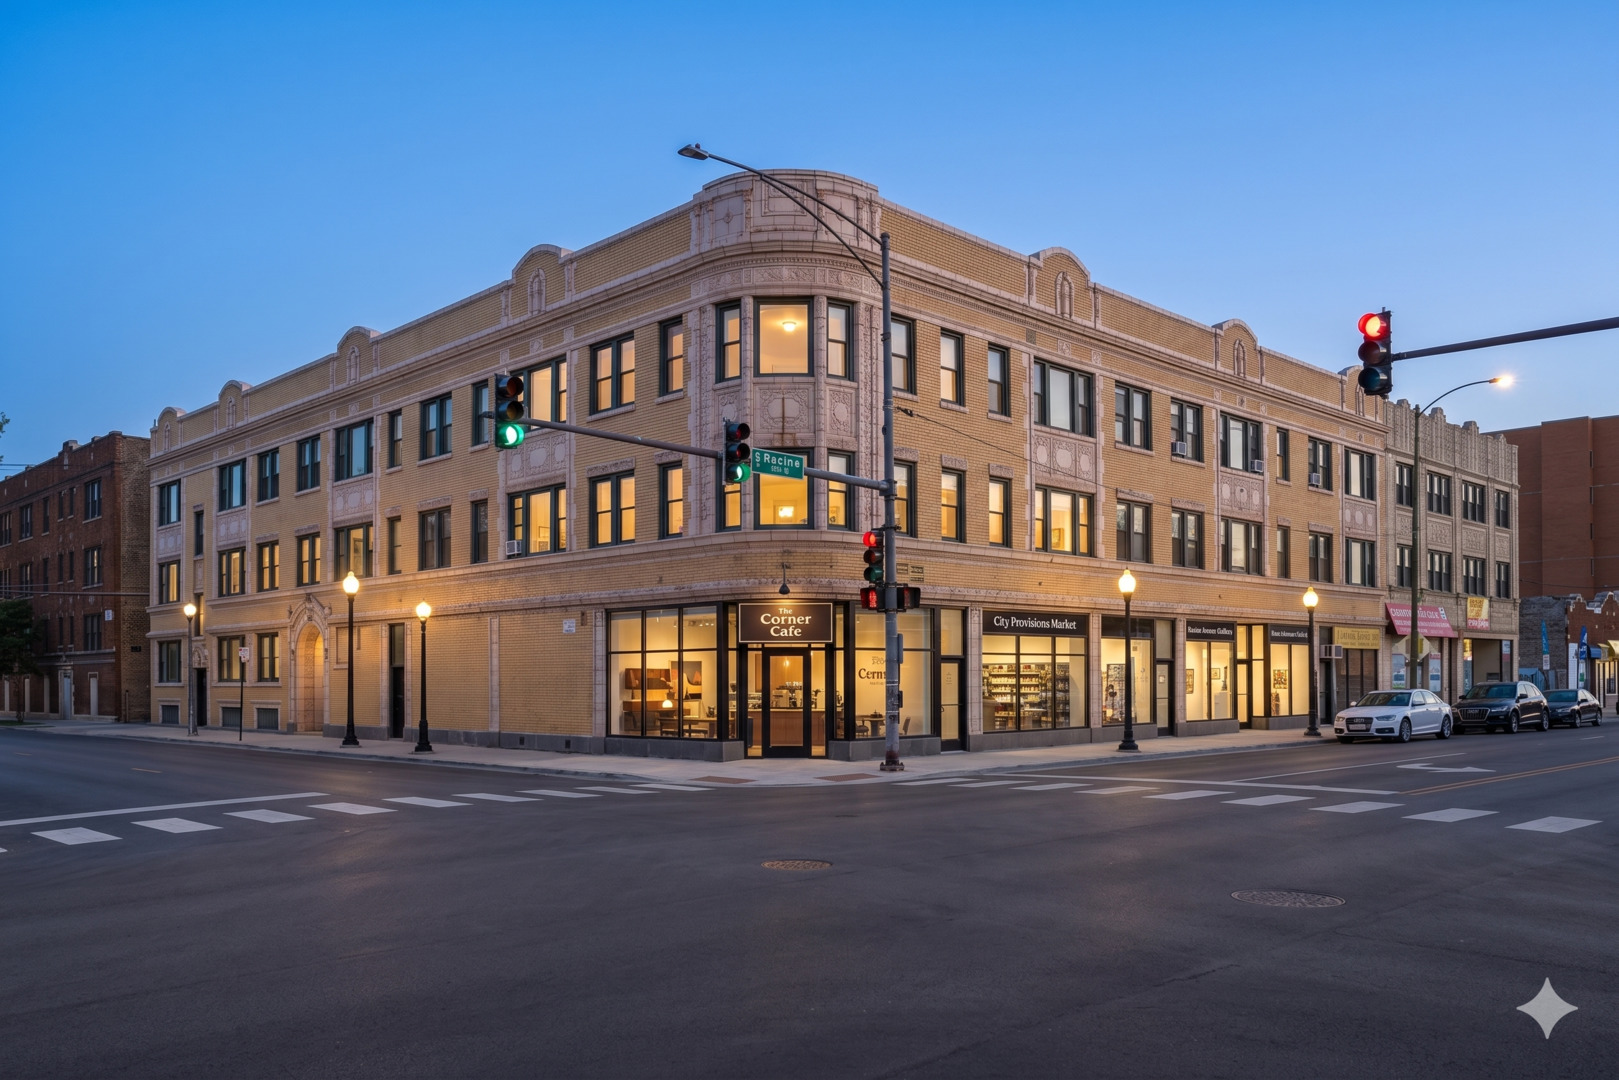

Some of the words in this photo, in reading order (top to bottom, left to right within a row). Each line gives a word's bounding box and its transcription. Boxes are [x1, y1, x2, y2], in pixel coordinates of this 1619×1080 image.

[755, 451, 761, 463] S
[763, 453, 801, 468] Racine
[760, 613, 812, 625] Corner
[993, 615, 1010, 629] City
[1010, 616, 1050, 629] Provisions
[1050, 618, 1077, 630] Market
[770, 625, 802, 637] Cafe
